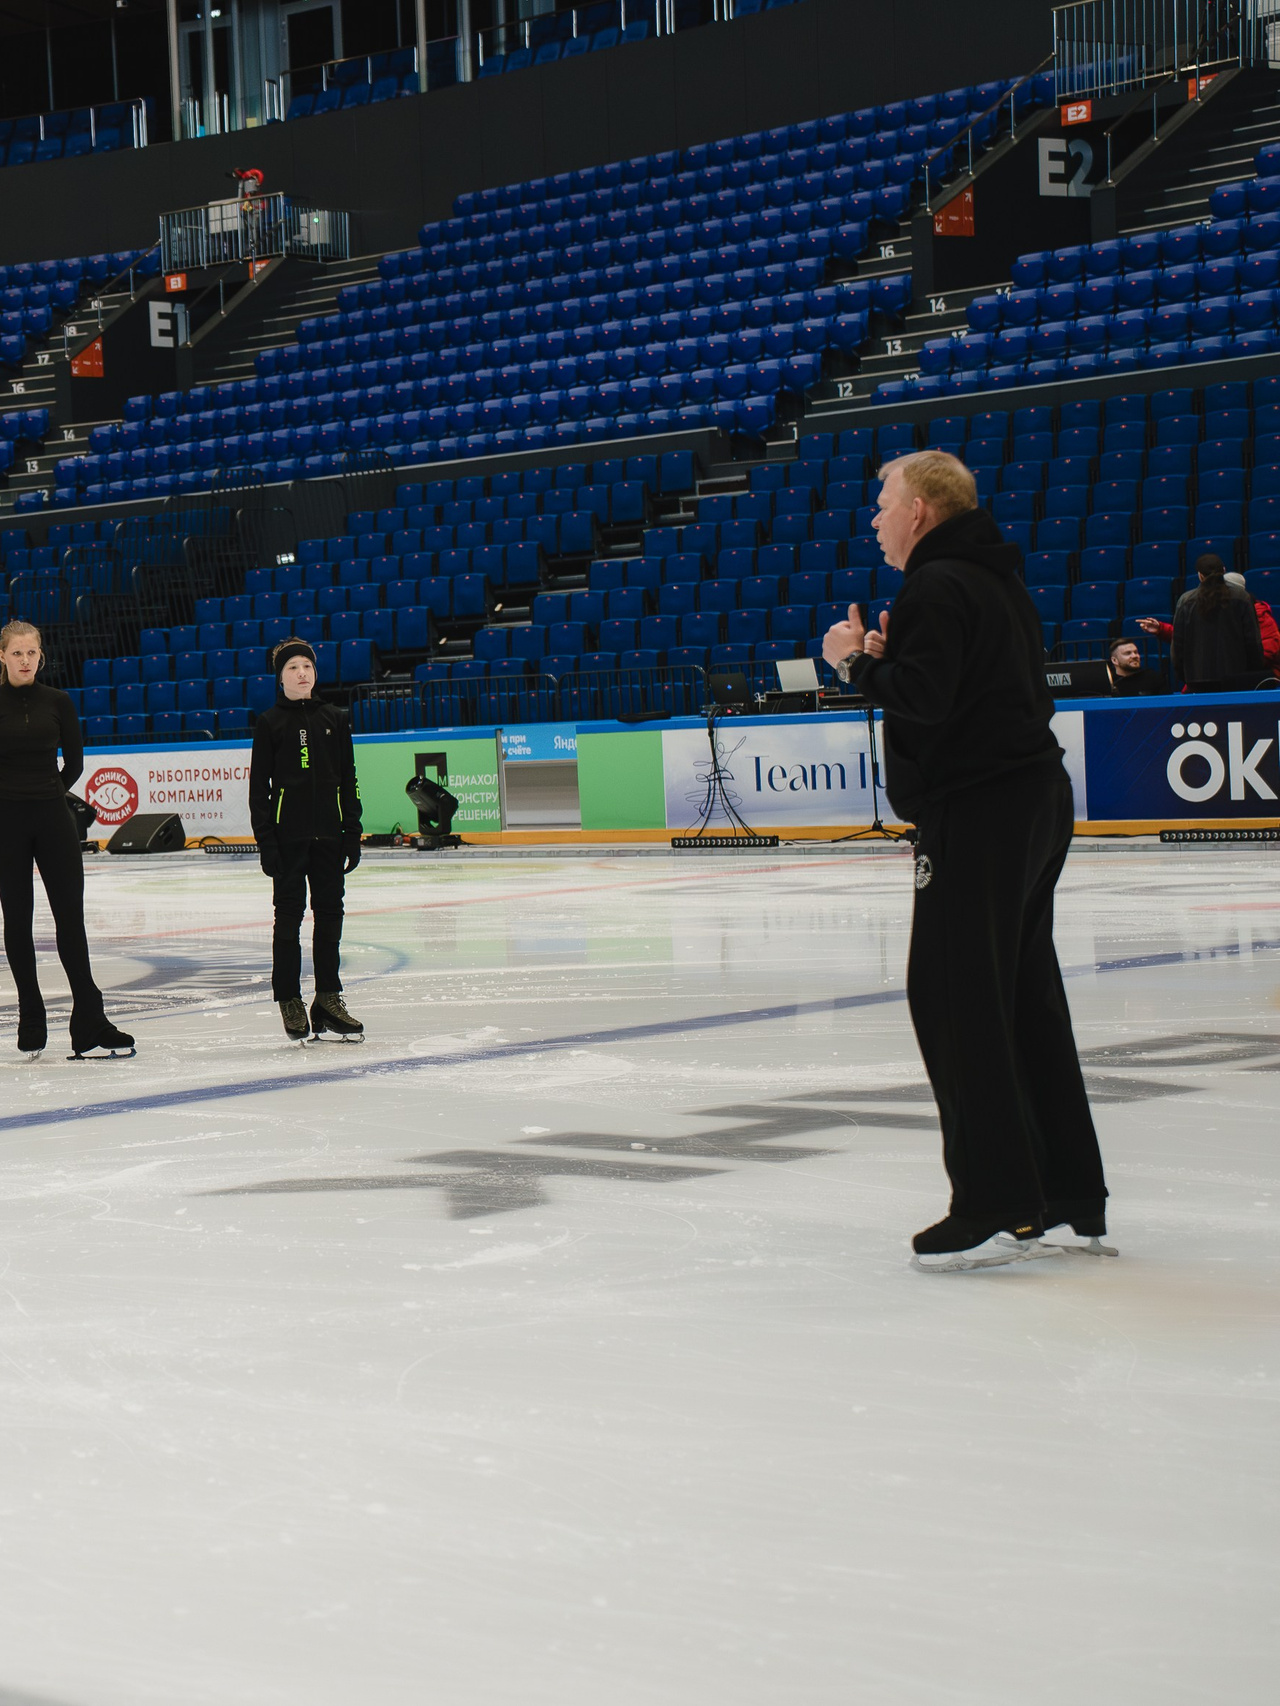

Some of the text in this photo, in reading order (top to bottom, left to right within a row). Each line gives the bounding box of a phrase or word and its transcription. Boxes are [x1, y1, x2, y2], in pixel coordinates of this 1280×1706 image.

[1067, 105, 1087, 122] E2
[1038, 137, 1095, 197] E2
[880, 245, 895, 259] 16
[170, 277, 181, 289] E1
[930, 298, 946, 313] 14
[149, 301, 187, 348] E1
[886, 340, 902, 356] 13
[37, 354, 50, 365] 17
[12, 383, 25, 394] 16
[837, 383, 853, 398] 12
[63, 430, 76, 441] 14
[26, 461, 39, 473] 13
[509, 735, 526, 745] при
[299, 729, 310, 768] FILA PRO
[94, 771, 128, 787] СОНИКО
[148, 767, 250, 783] РЫБОПРОМЫСЛ
[745, 755, 847, 792] Team
[149, 789, 223, 804] КОМПАНИЯ
[200, 812, 224, 820] МОРЕ
